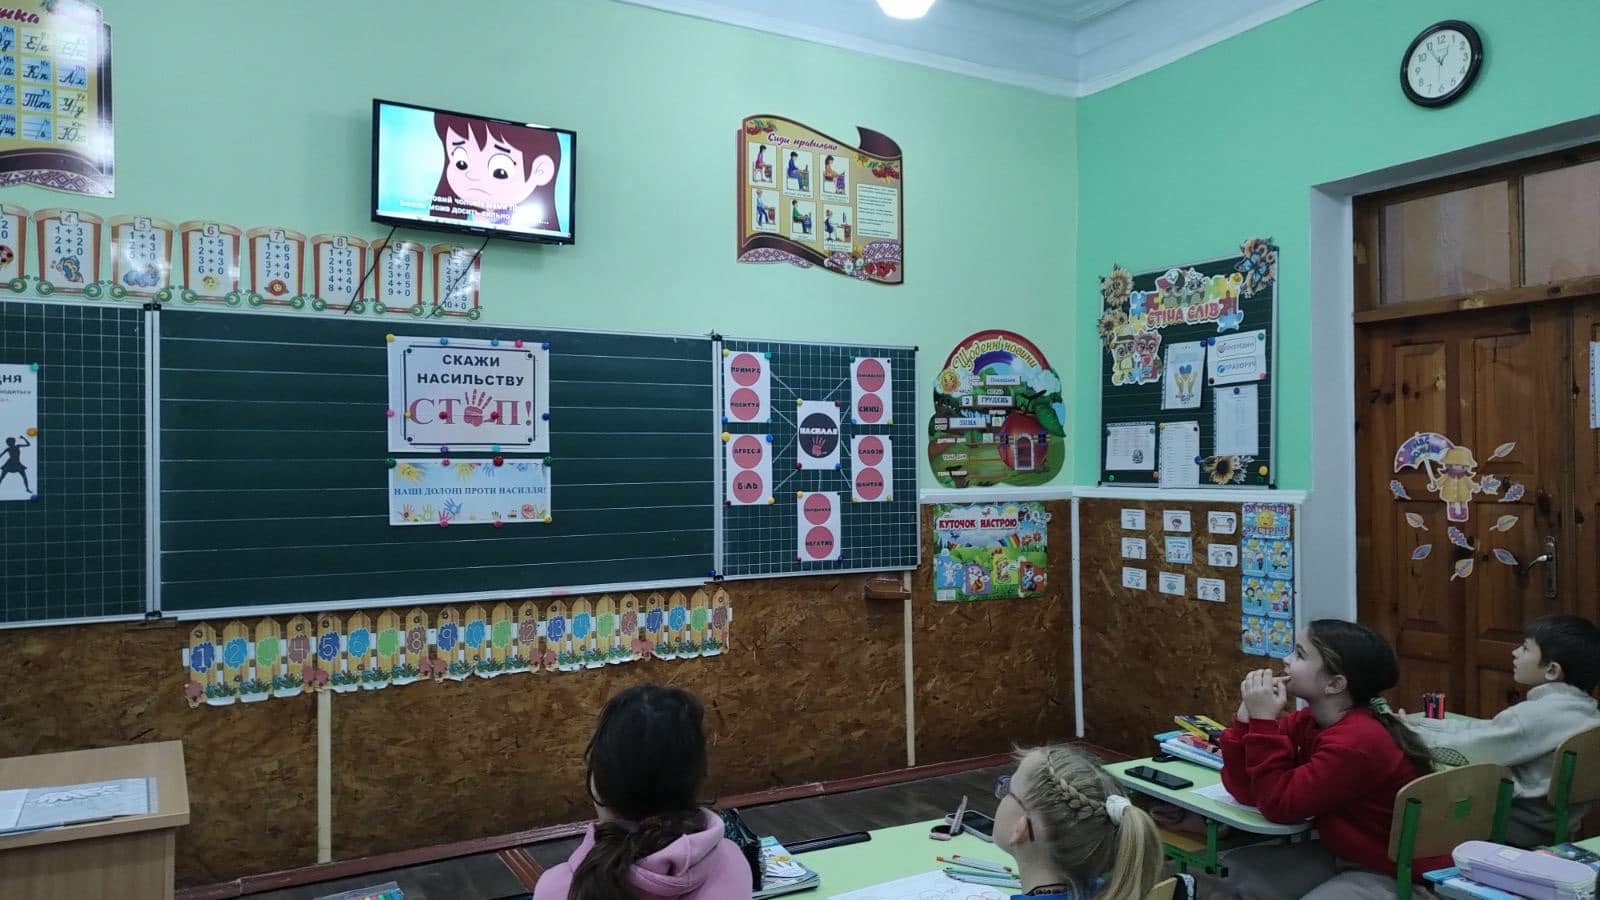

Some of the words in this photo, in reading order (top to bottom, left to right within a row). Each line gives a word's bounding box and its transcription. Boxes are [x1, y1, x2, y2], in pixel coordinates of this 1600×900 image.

[768, 133, 790, 146] Сиди
[442, 354, 500, 367] СКАЖИ
[417, 373, 524, 386] НАСИЛЬСТВУ
[394, 487, 422, 496] НАШІ
[424, 487, 462, 496] ДОЛОНІ
[465, 487, 496, 495] ПРОТИ
[500, 486, 546, 495] НАСИЛЛЯ!
[939, 520, 976, 528] КУТОЧОК
[980, 519, 1017, 528] НАСТРОЮ
[196, 648, 206, 668] 1
[231, 645, 240, 663] 2
[294, 639, 304, 660] 4
[322, 638, 333, 656] 5
[412, 631, 422, 650] 8
[442, 629, 452, 647] 9
